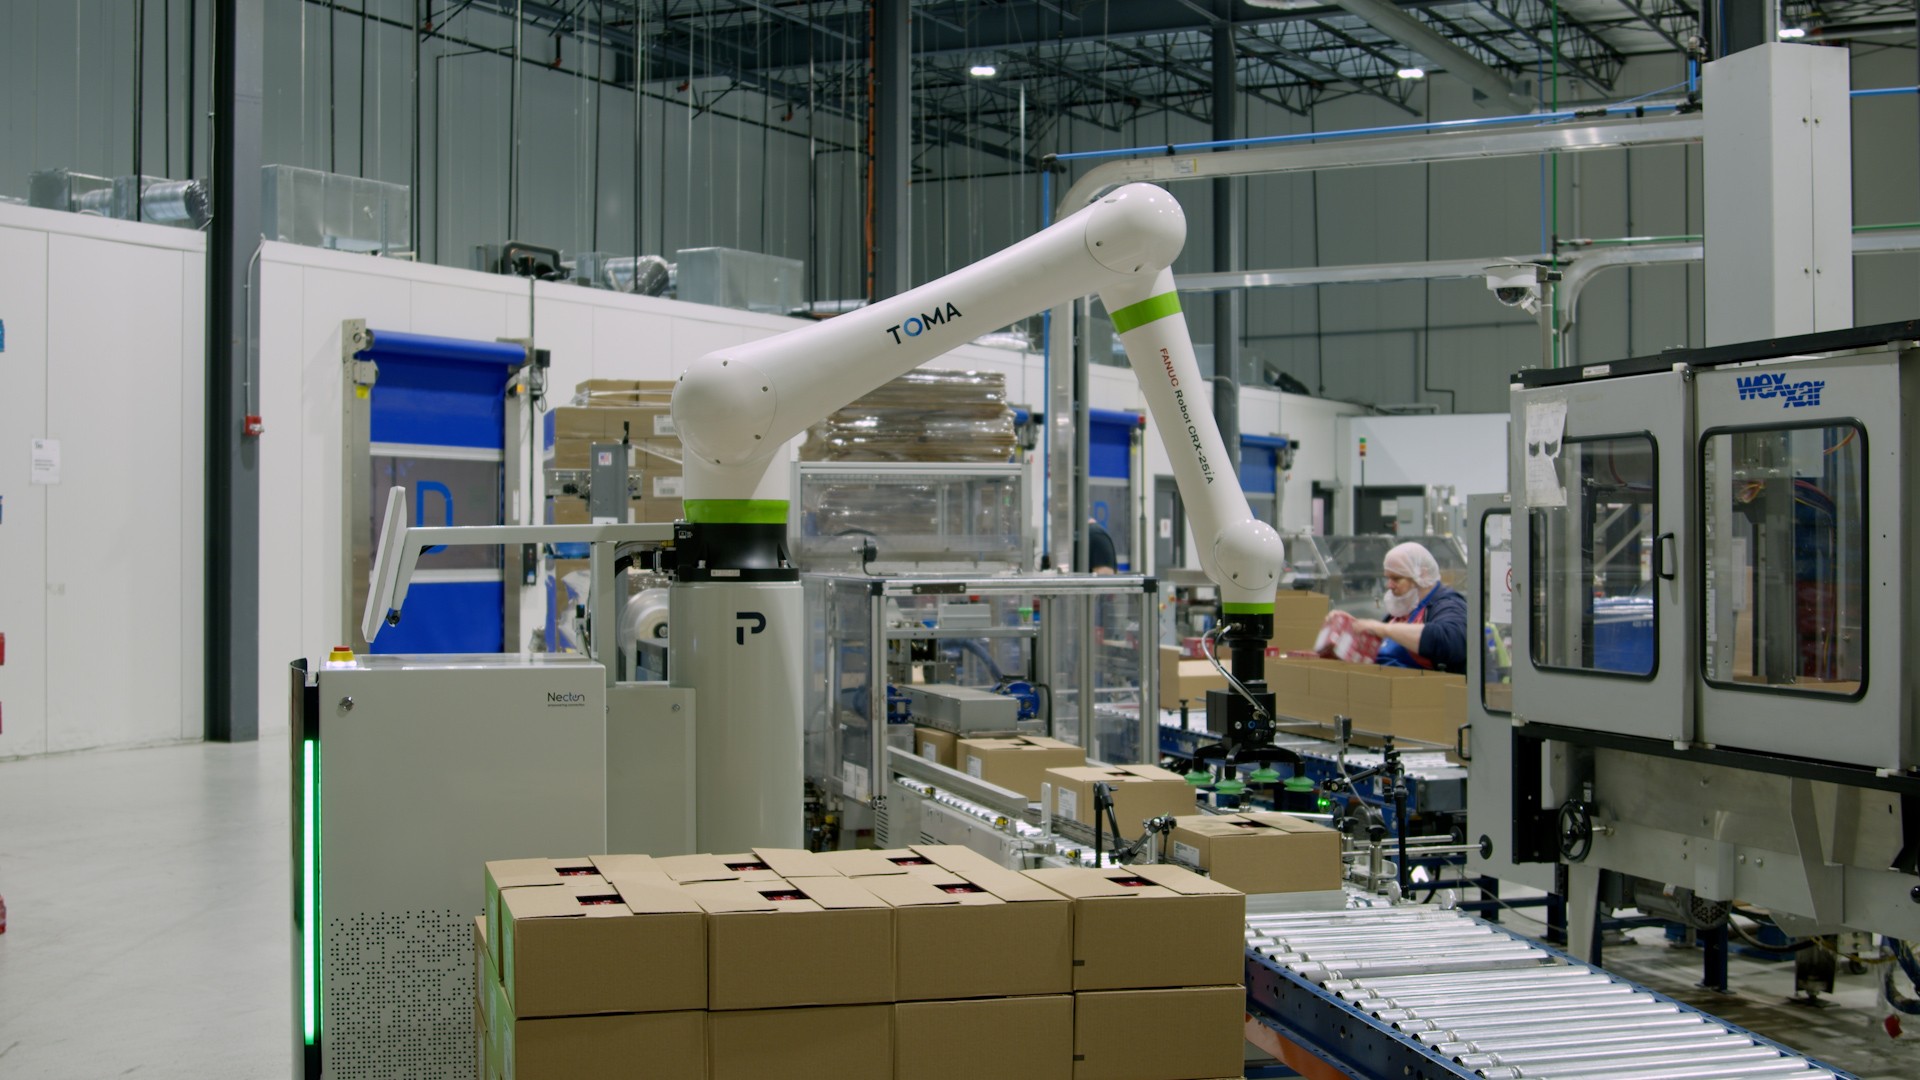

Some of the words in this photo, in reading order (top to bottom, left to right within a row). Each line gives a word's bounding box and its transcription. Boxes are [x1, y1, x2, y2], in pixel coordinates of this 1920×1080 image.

[886, 302, 962, 344] TOMA
[1160, 347, 1179, 387] FANUC
[1174, 390, 1192, 424] Robot
[1188, 426, 1215, 484] CRX-25iA
[547, 692, 585, 702] Necton
